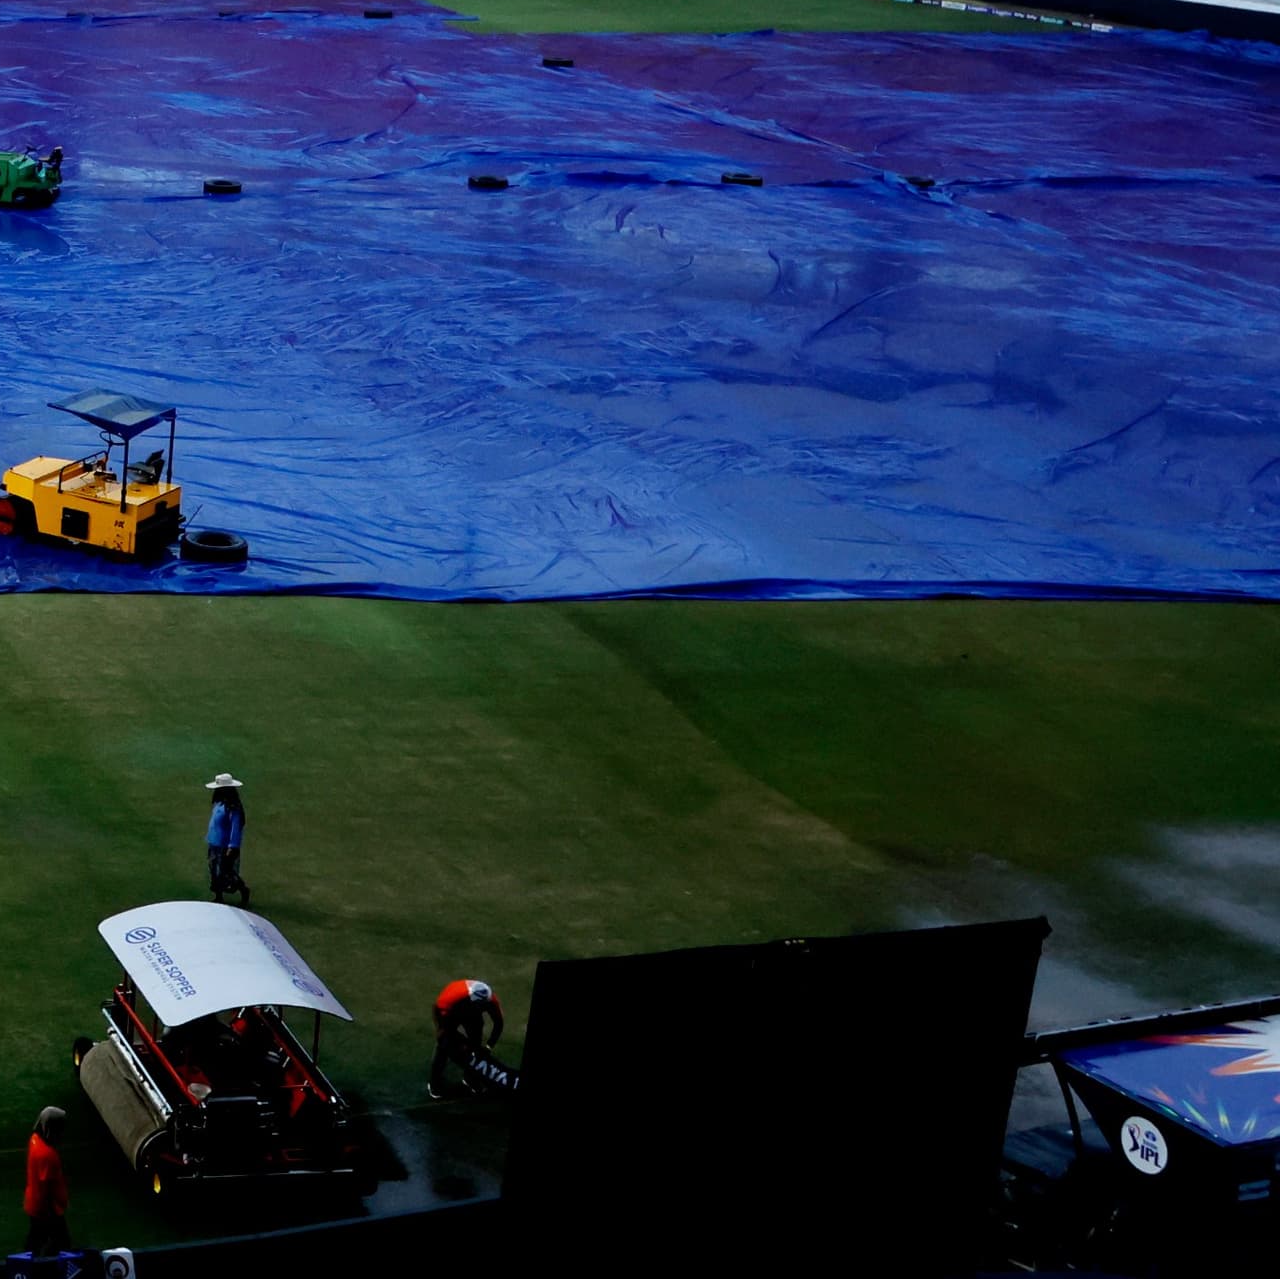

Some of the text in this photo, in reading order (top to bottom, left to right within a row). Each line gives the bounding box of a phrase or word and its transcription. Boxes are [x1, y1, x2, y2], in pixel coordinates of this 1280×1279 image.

[147, 942, 196, 997] SUPER SOPPER
[1140, 1145, 1162, 1168] IPL
